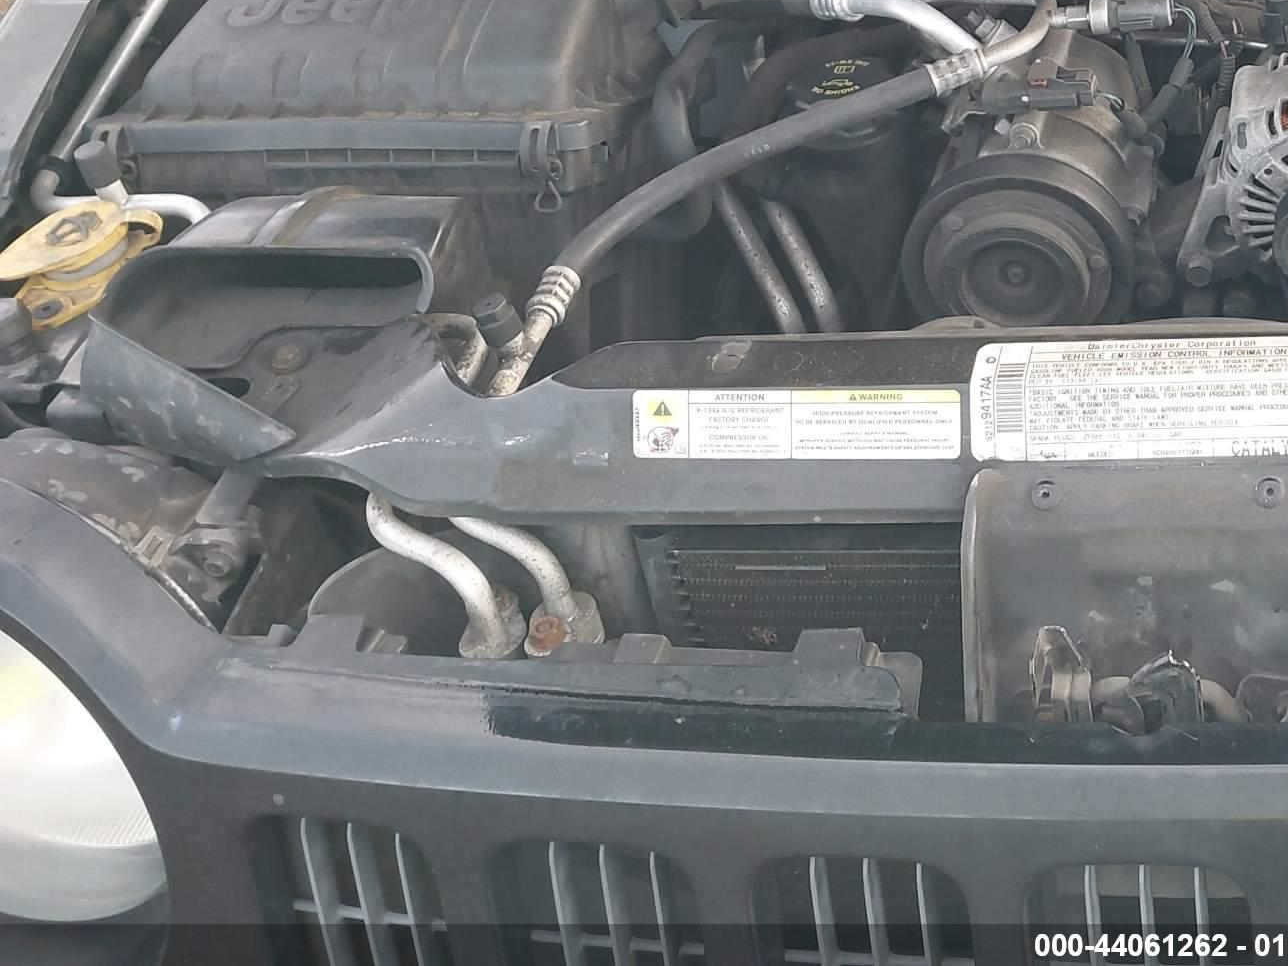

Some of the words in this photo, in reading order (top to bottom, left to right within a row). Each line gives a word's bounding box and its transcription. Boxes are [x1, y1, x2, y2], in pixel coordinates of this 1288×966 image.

[1088, 342, 1180, 350] DaimlerChrysler
[1188, 339, 1256, 349] Corporation
[1062, 353, 1105, 361] VEHICLE
[1111, 351, 1162, 359] EMISSION
[1168, 350, 1208, 358] CONTROL
[1220, 348, 1288, 356] INFORMATION
[1095, 386, 1119, 394] TIMING
[715, 393, 765, 401] ATTENTION
[859, 393, 903, 401] WARNING
[1103, 393, 1131, 401] SERVICE
[1209, 389, 1251, 397] PROCEDURES
[1161, 405, 1194, 413] APPROVED
